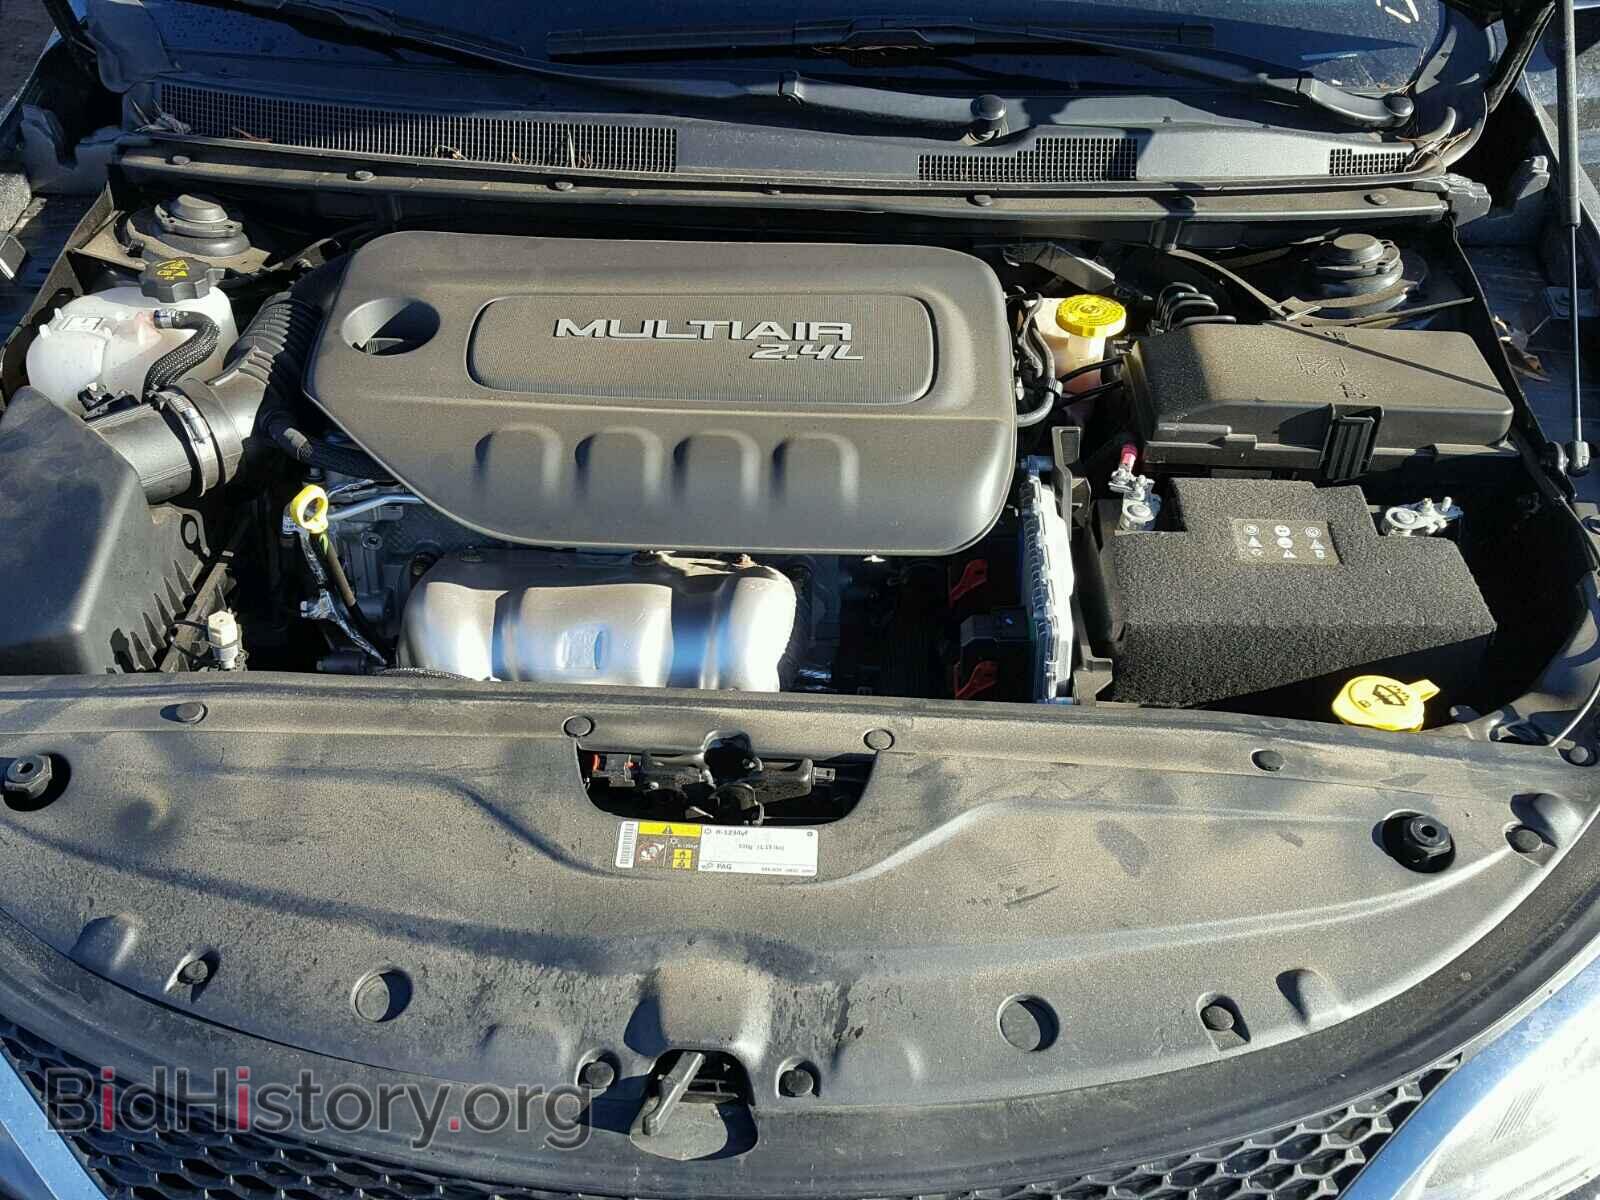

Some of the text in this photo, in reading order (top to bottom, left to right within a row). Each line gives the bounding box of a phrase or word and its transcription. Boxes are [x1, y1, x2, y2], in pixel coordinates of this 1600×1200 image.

[553, 318, 852, 341] MULTIAIR
[750, 344, 864, 360] 2.4L
[716, 862, 732, 871] PAG
